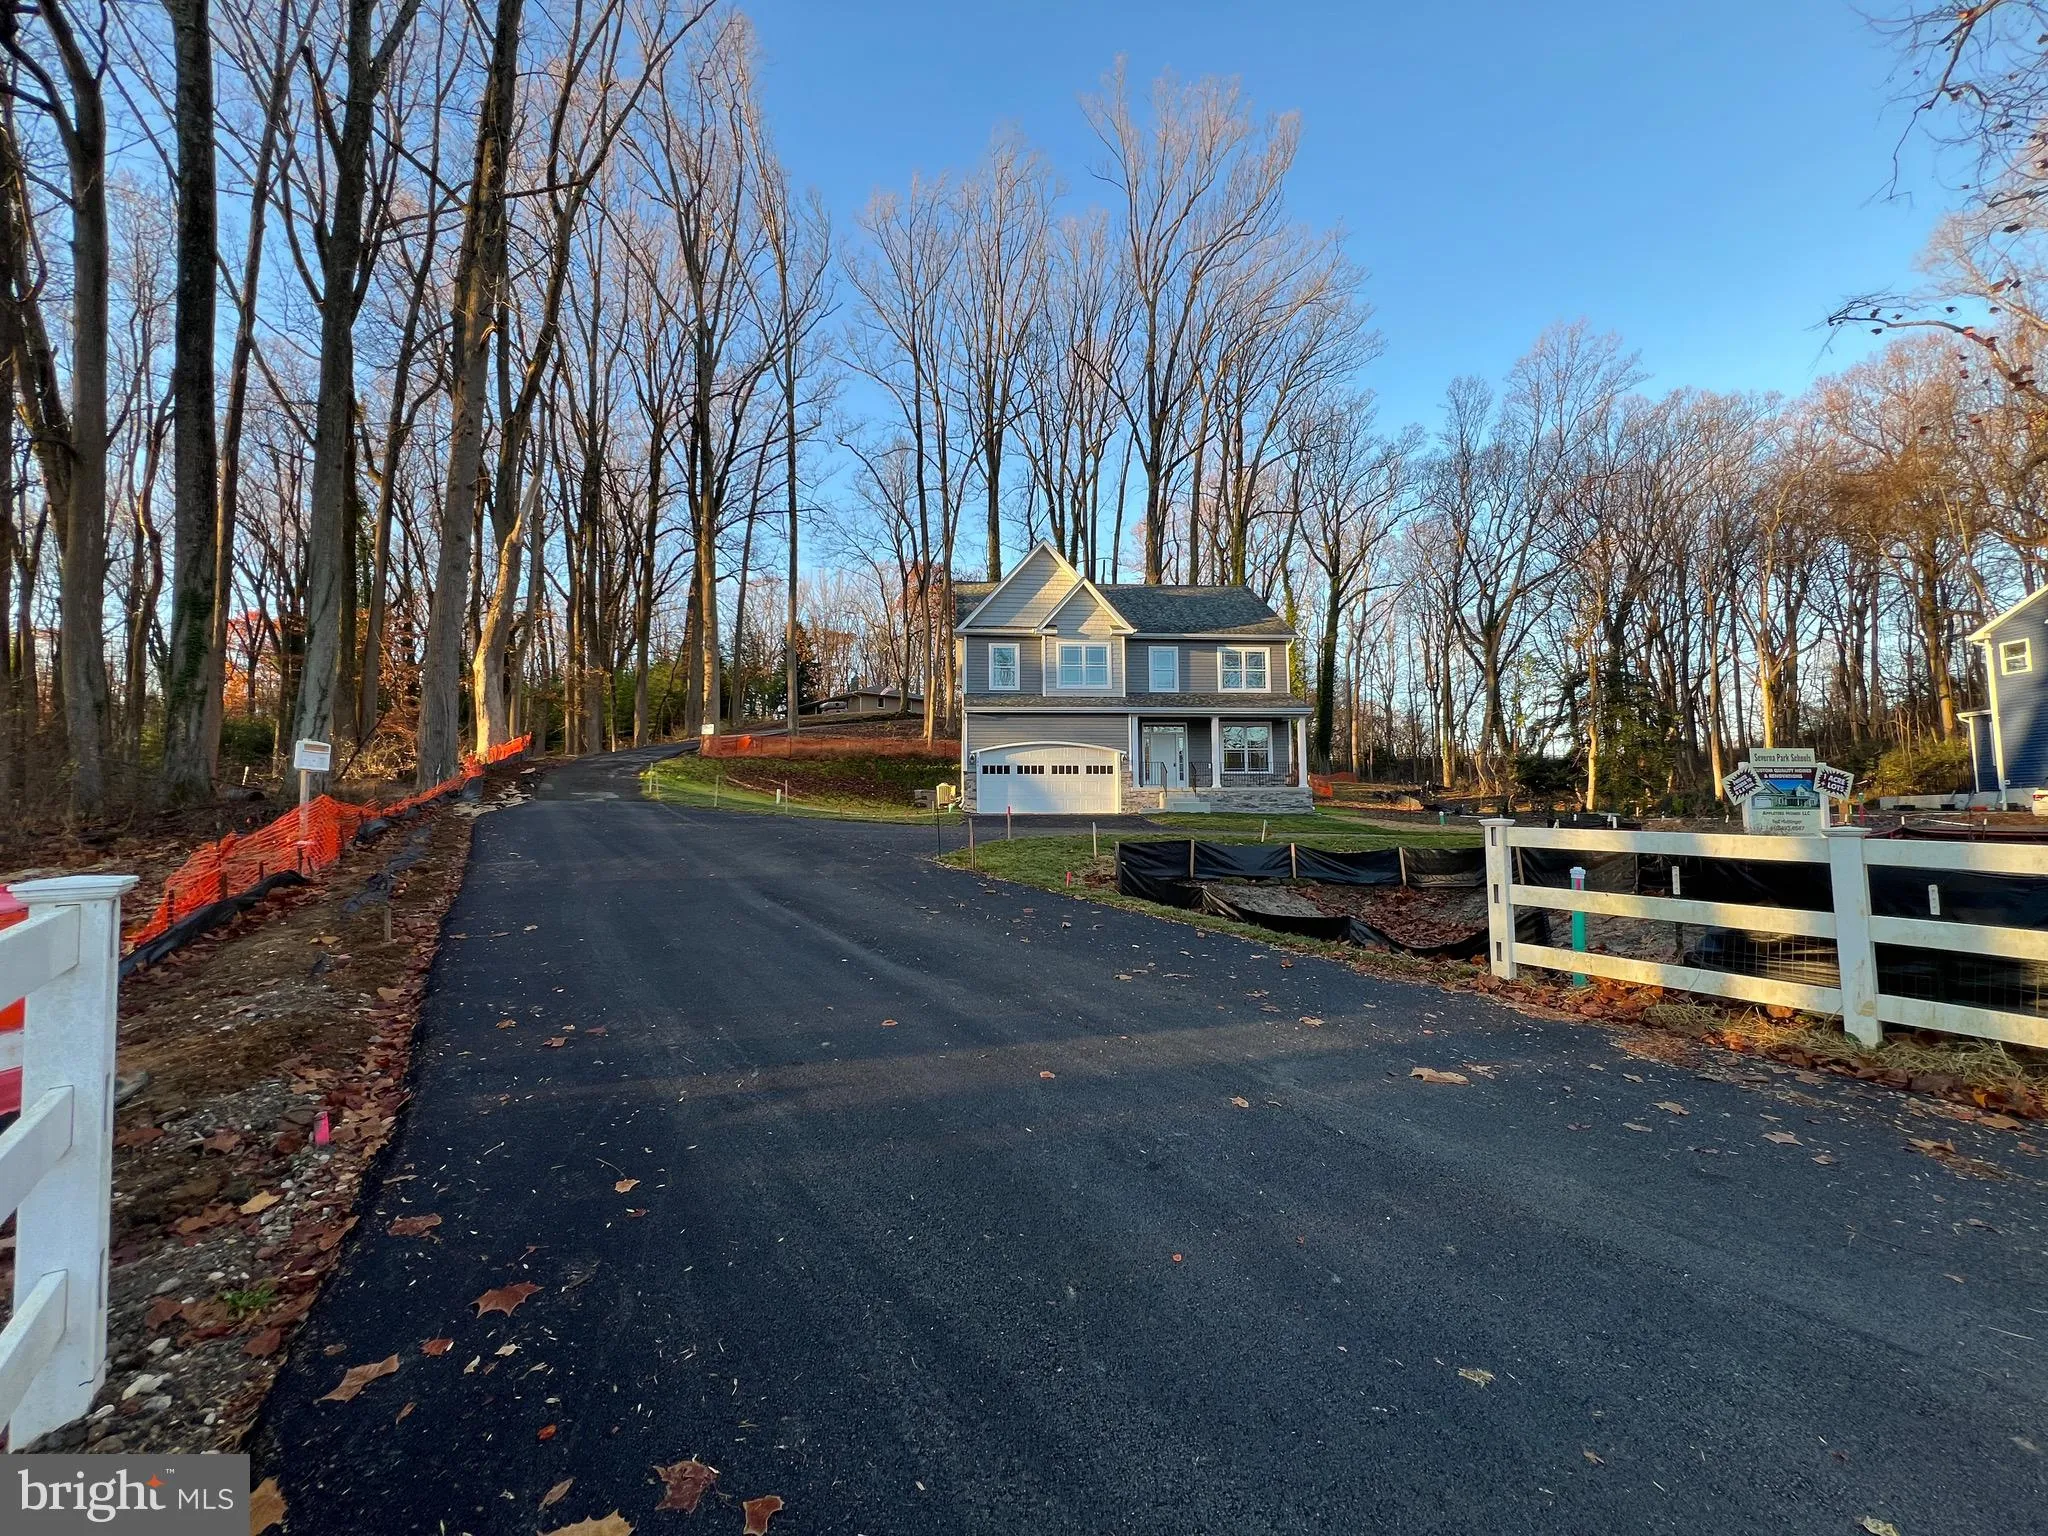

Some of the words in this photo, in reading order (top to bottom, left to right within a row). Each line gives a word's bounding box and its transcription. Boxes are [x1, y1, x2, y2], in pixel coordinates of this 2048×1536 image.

[1754, 753, 1775, 762] Severna
[1776, 753, 1790, 762] Park
[1790, 753, 1812, 762] Schools
[1828, 775, 1846, 786] ACRE
[1827, 781, 1845, 792] LOTS
